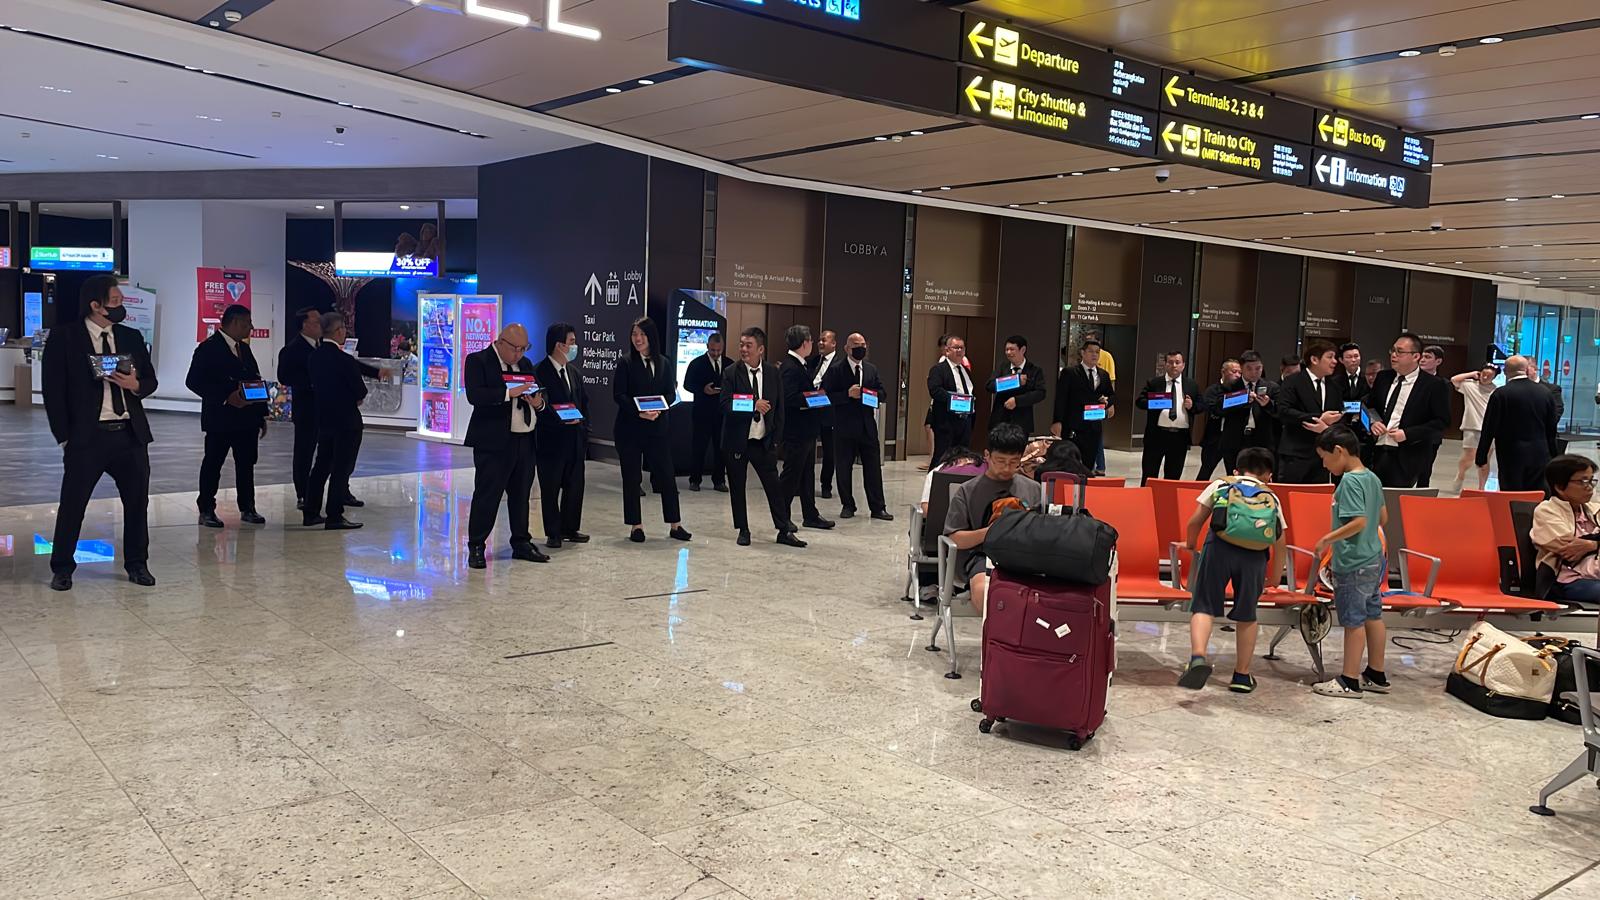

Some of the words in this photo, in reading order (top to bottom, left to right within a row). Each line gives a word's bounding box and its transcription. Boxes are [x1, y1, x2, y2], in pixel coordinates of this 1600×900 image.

[1021, 43, 1080, 74] Departure
[1018, 87, 1038, 108] City
[1041, 93, 1076, 115] Shuttle
[1078, 103, 1087, 118] &
[1187, 87, 1230, 111] Terminals
[1231, 98, 1239, 115] 2,
[1241, 101, 1248, 115] 3
[1249, 102, 1256, 118] &
[1257, 105, 1264, 119] 4
[1017, 106, 1069, 130] Limousine
[1203, 128, 1226, 147] Train
[1227, 134, 1238, 149] to
[1239, 136, 1256, 156] City
[1349, 128, 1362, 143] Bus
[1363, 132, 1371, 145] to
[1372, 134, 1386, 152] City
[1201, 147, 1219, 160] (MRT
[1220, 151, 1242, 165] Station
[1243, 157, 1250, 167] at
[1250, 157, 1261, 170] T3)
[1346, 167, 1387, 188] Information
[844, 241, 878, 256] LOBBY
[880, 246, 887, 256] A
[415, 258, 431, 267] OFF
[623, 270, 643, 282] Lobby
[769, 274, 785, 282] Arrival
[1154, 274, 1177, 285] LOBBY
[204, 281, 224, 289] FREE
[627, 283, 639, 305] A
[465, 318, 491, 332] NO.1
[584, 314, 596, 325] Taxi
[678, 318, 718, 328] INFORMATION
[584, 331, 591, 341] T1
[591, 332, 602, 342] Car
[602, 332, 616, 342] Park
[583, 347, 617, 360] Ride-Hailing
[618, 349, 623, 358] &
[582, 359, 602, 370] Arrival
[582, 375, 596, 384] Doors
[596, 376, 599, 385] 7
[602, 377, 608, 385] 12
[435, 401, 449, 411] NO.1
